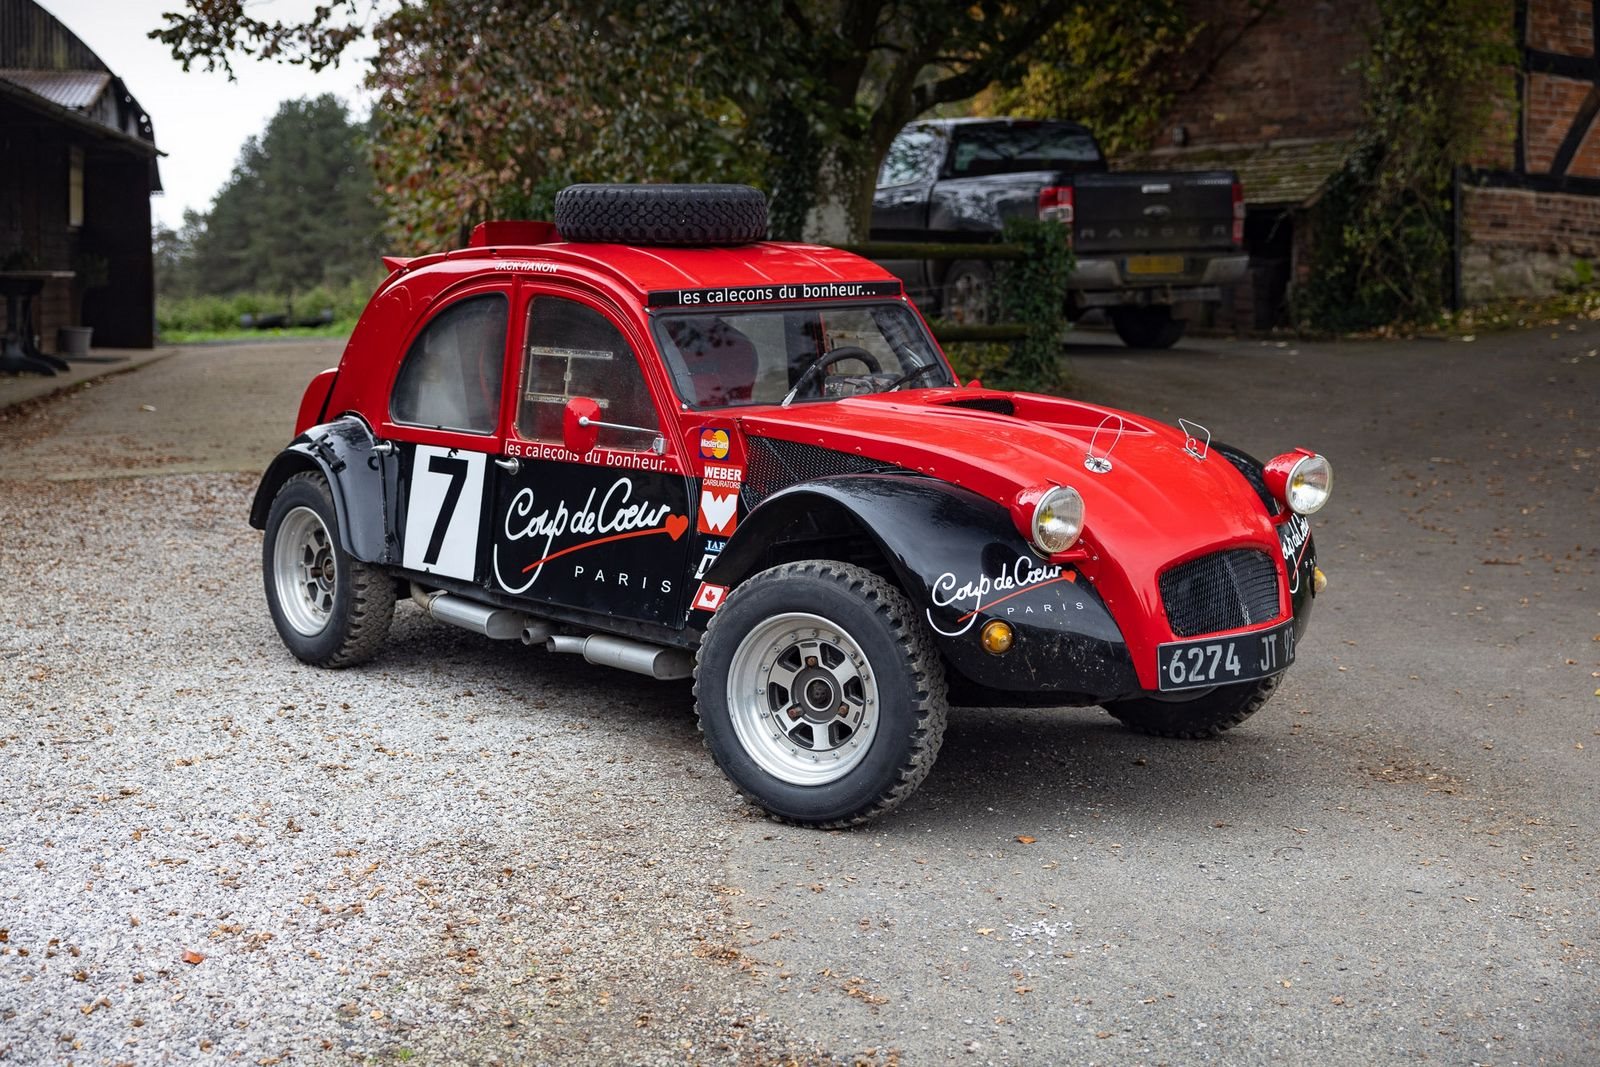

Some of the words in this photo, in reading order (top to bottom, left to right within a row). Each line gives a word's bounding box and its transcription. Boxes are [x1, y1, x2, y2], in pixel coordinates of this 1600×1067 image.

[1080, 224, 1227, 239] RANGER
[678, 290, 700, 304] les
[706, 287, 774, 303] caleçons
[779, 284, 797, 299] du
[803, 283, 877, 298] bonheur...
[504, 440, 521, 455] les
[585, 450, 601, 464] du
[606, 451, 679, 472] bonheur...
[702, 478, 741, 489] CARBURATORS
[704, 466, 742, 481] WEBER
[422, 455, 469, 567] 7
[570, 487, 597, 535] de
[574, 565, 672, 593] PARIS
[994, 563, 1015, 589] de
[1007, 602, 1084, 615] PARIS
[1169, 642, 1241, 684] 6274
[1260, 634, 1277, 671] JT
[1283, 627, 1295, 662] 92
